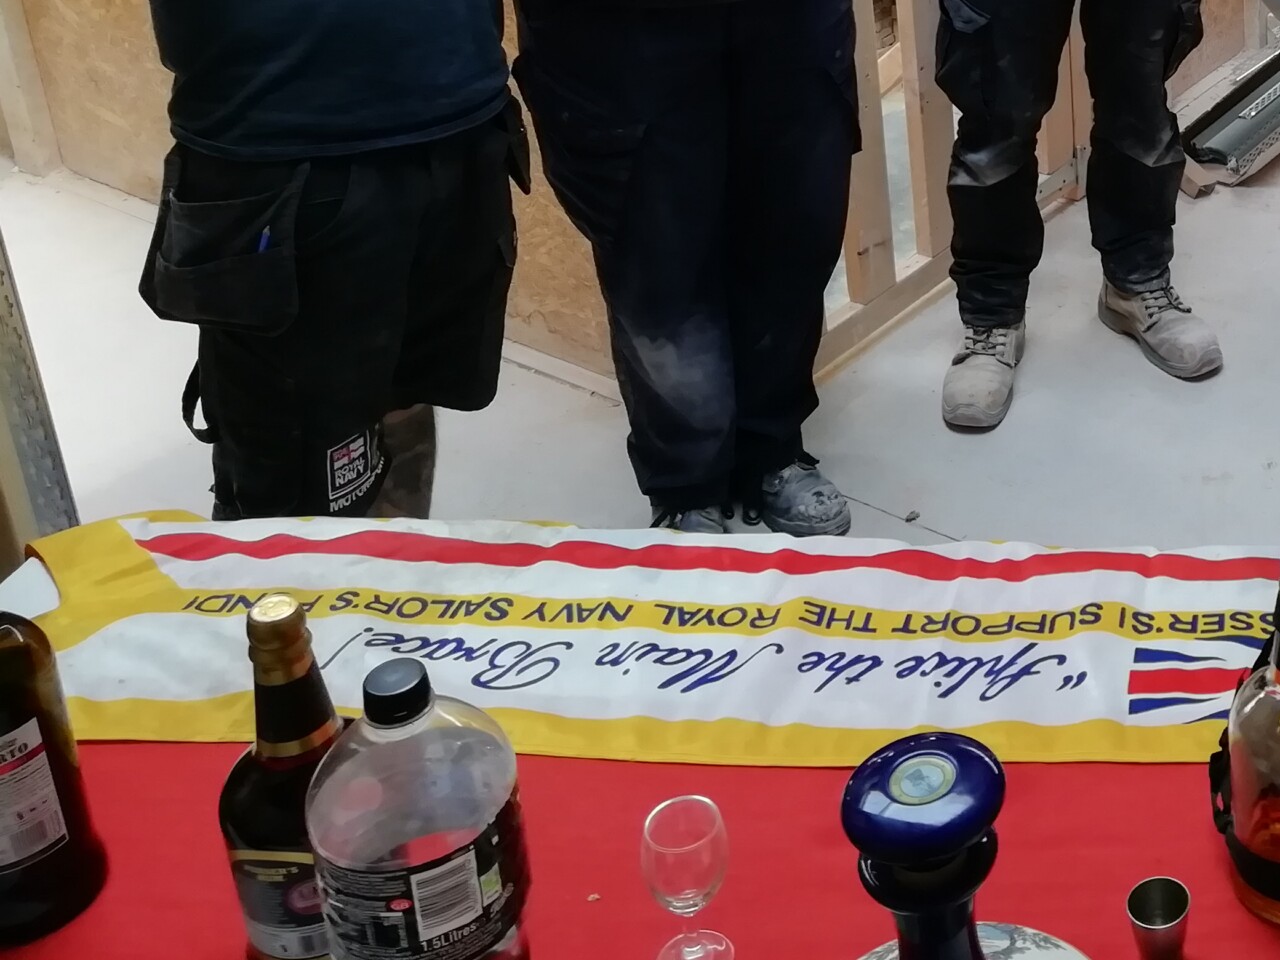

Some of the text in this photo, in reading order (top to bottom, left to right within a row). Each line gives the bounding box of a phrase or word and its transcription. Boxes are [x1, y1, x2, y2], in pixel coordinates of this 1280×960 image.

[334, 456, 366, 477] ROYAL
[335, 463, 366, 487] NAVY
[328, 590, 515, 621] SAILOR'S
[521, 600, 634, 625] NAVY
[654, 603, 782, 629] ROYAL
[798, 600, 877, 634] THE
[890, 602, 1105, 636] SUPPORT
[319, 626, 574, 691] Brace!
[594, 640, 785, 694] Main
[797, 648, 885, 694] the
